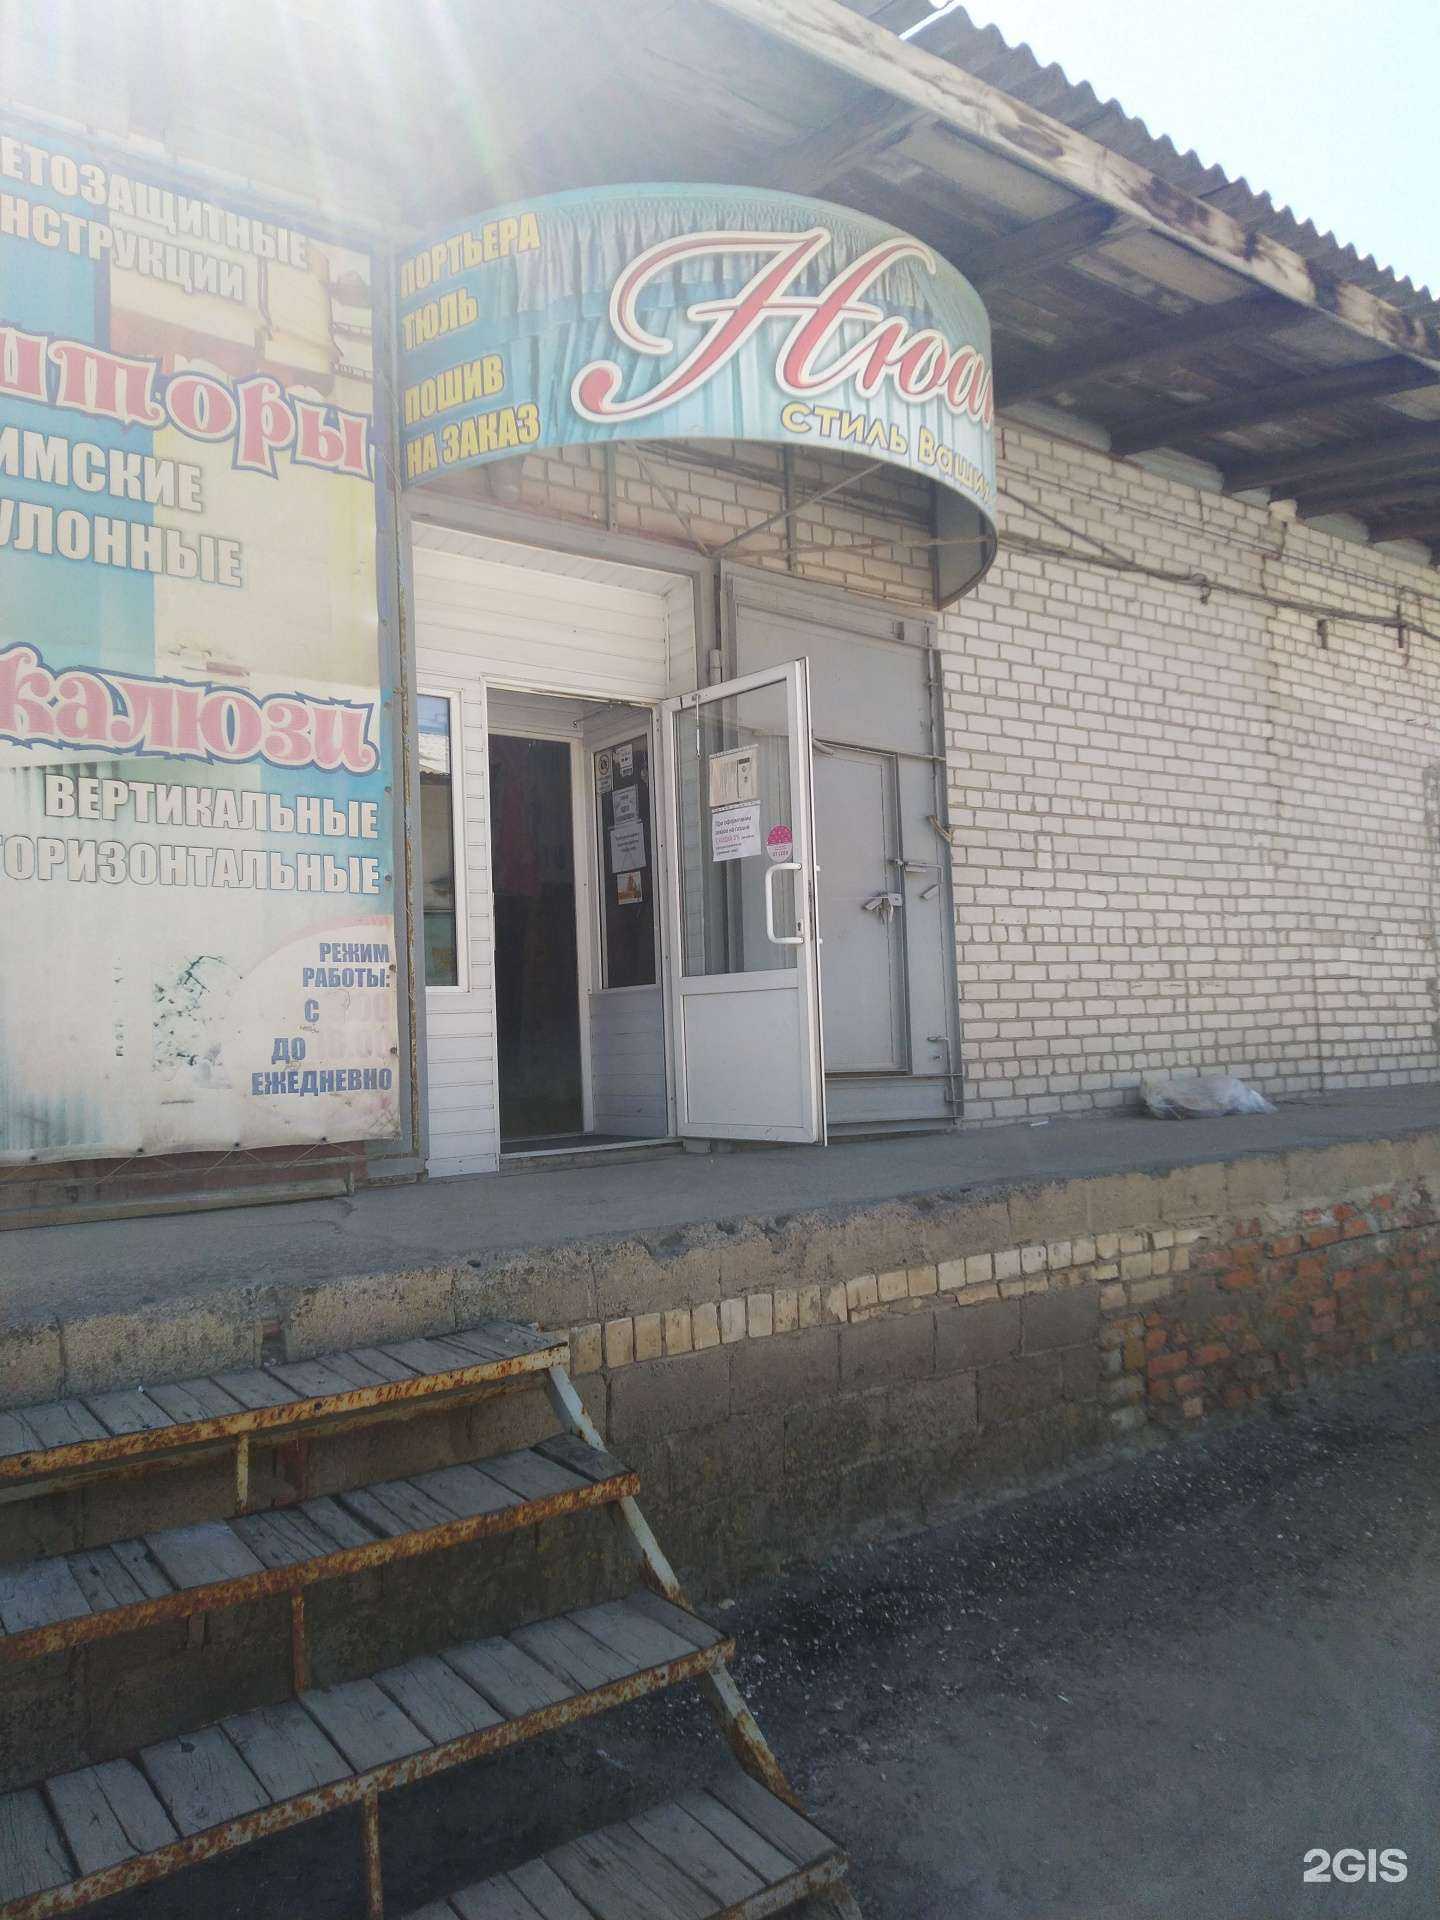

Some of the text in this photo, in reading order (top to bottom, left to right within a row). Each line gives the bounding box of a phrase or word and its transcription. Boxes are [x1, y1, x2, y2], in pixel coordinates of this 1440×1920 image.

[401, 212, 541, 299] ПОРТЬЕРА
[401, 286, 479, 351] ТЮЛЬ
[404, 353, 505, 426] ПОШИВ
[406, 402, 541, 482] НА ЗАКАЗ
[45, 774, 379, 841] ВЕРТИКАЛЬНЫЕ
[0, 835, 380, 895] ОРИЗОНТАЛЬНЫЕ
[302, 968, 391, 988] РАБОТЫ:
[319, 943, 390, 963] РЕЖИМ
[304, 1000, 320, 1023] С
[271, 1037, 306, 1064] ДО
[251, 1068, 393, 1096] ЕЖЕДНЕВНО
